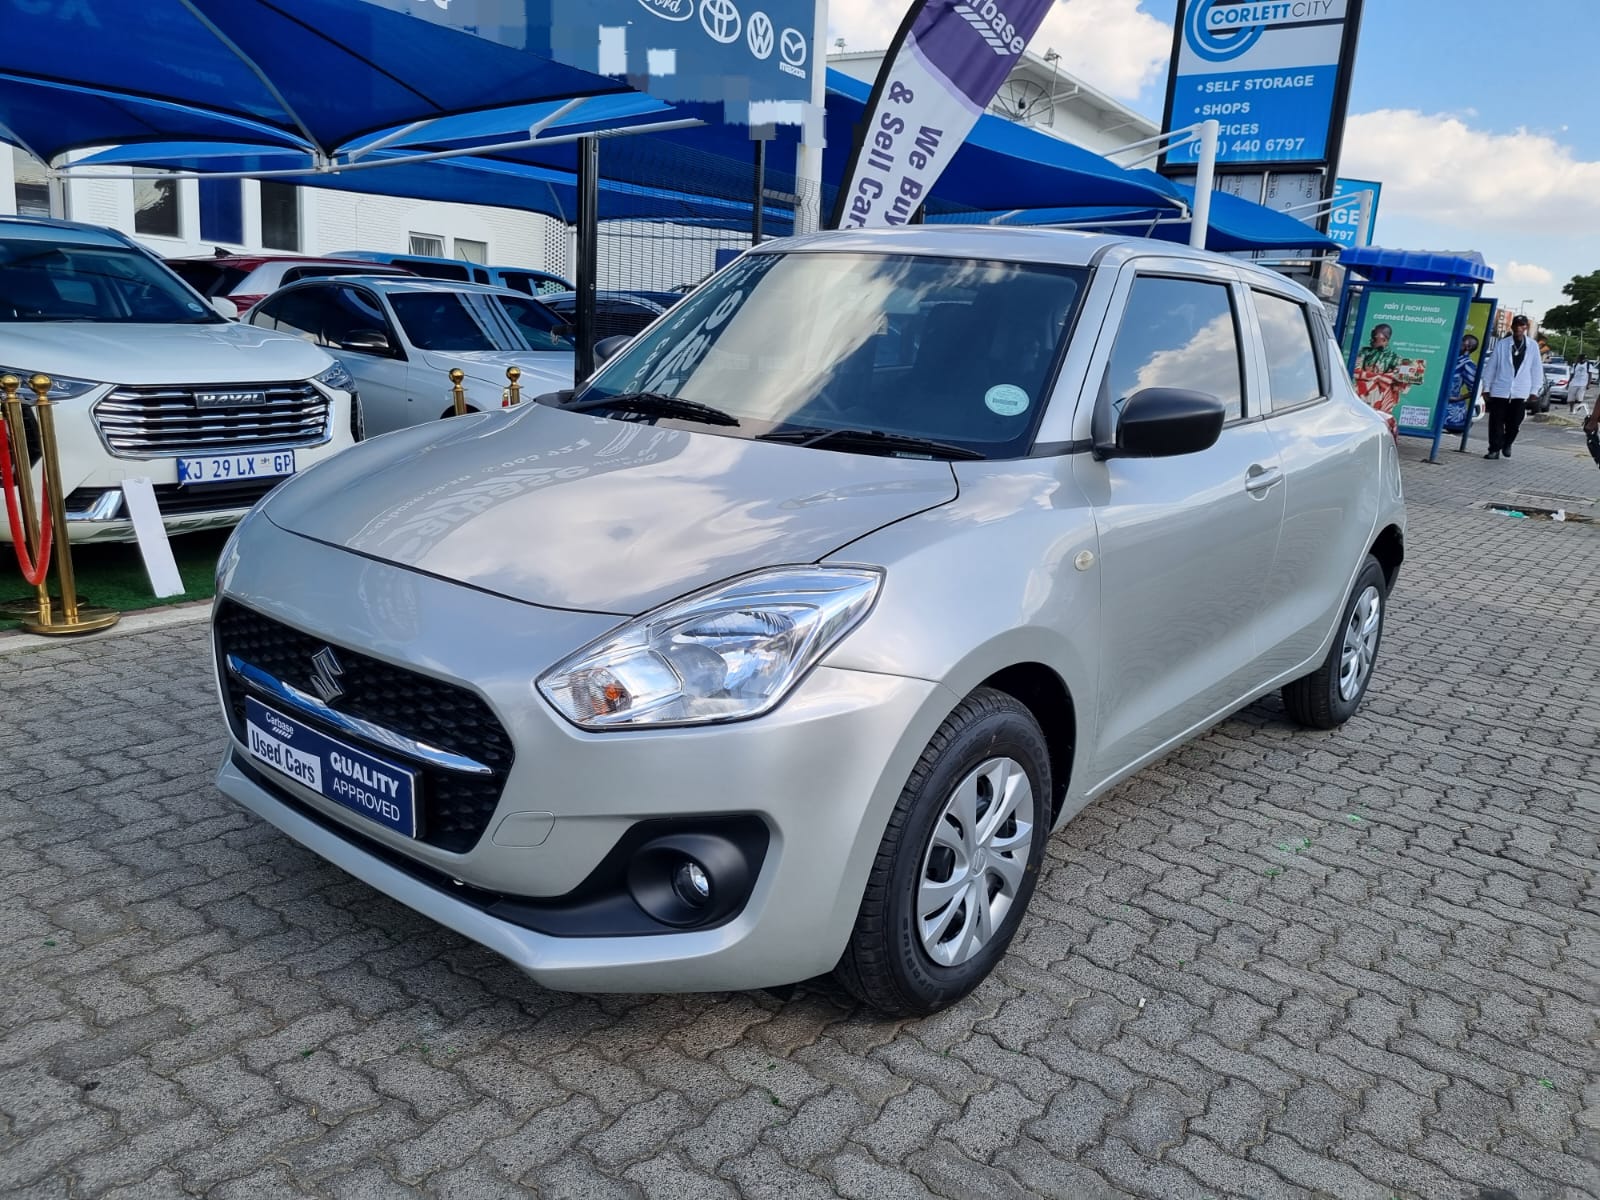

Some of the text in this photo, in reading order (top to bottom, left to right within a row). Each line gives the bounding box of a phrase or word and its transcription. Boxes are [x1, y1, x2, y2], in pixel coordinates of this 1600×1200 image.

[1205, 75, 1314, 93] SELF STORAGE
[1202, 102, 1250, 115] SHOPS
[846, 81, 913, 229] & Sell Car
[909, 126, 943, 170] We
[1232, 140, 1260, 152] 440
[1265, 138, 1305, 152] 6797
[212, 459, 231, 477] 29
[236, 457, 256, 475] LX
[273, 454, 291, 472] GP
[266, 711, 294, 735] Carbase
[251, 729, 315, 784] Used Cars
[330, 751, 399, 798] QUALITY
[333, 777, 400, 822] APPROVED
